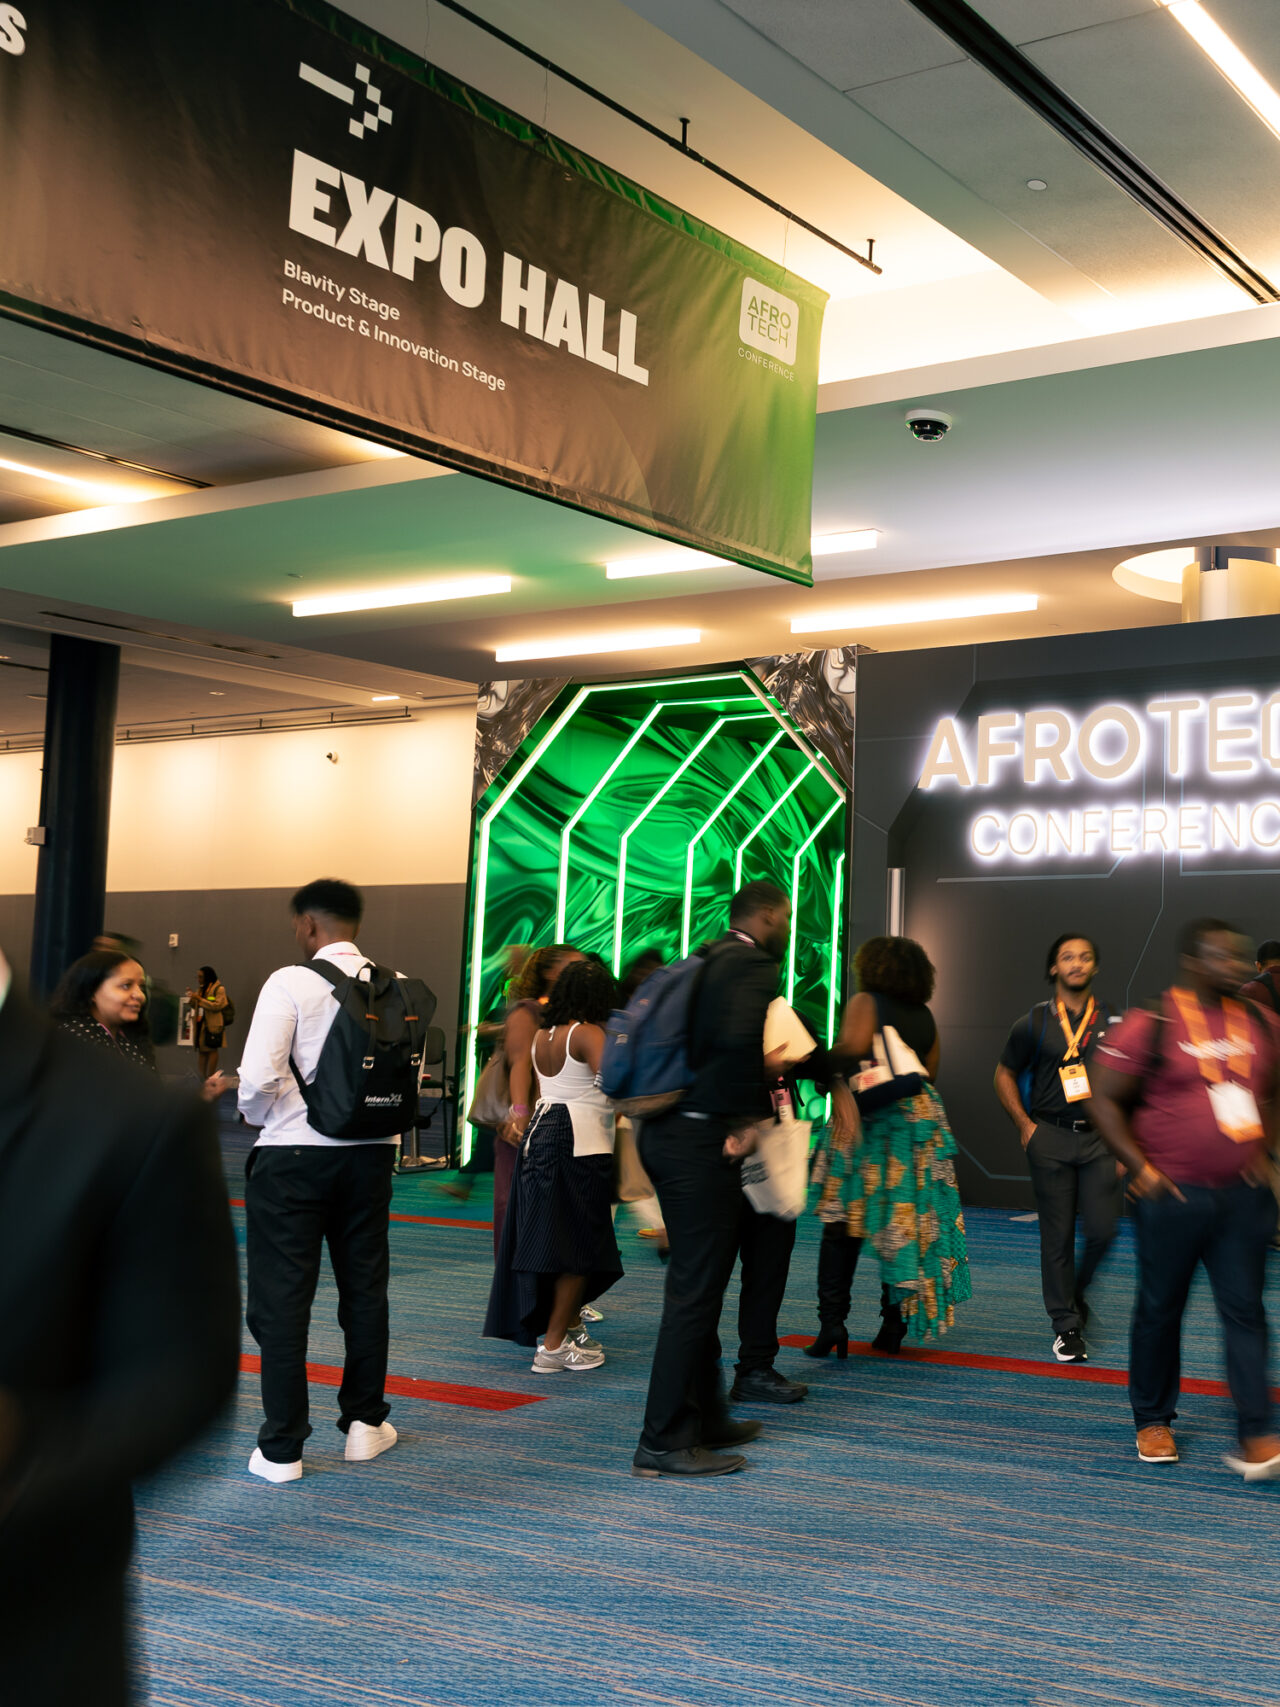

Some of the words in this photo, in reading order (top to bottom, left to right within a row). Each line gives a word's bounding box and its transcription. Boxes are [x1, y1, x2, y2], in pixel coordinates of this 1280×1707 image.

[289, 148, 487, 309] EXPO
[501, 251, 649, 386] HALL
[284, 259, 346, 302] Blavity
[349, 287, 401, 321] Stage
[747, 312, 789, 349] TECH
[748, 295, 792, 330] AFRO
[282, 288, 355, 332] Product
[358, 320, 371, 337] &
[374, 325, 459, 372] Innovation
[461, 361, 506, 391] Stage
[737, 347, 795, 382] CONFERENCE
[565, 1351, 580, 1363] N
